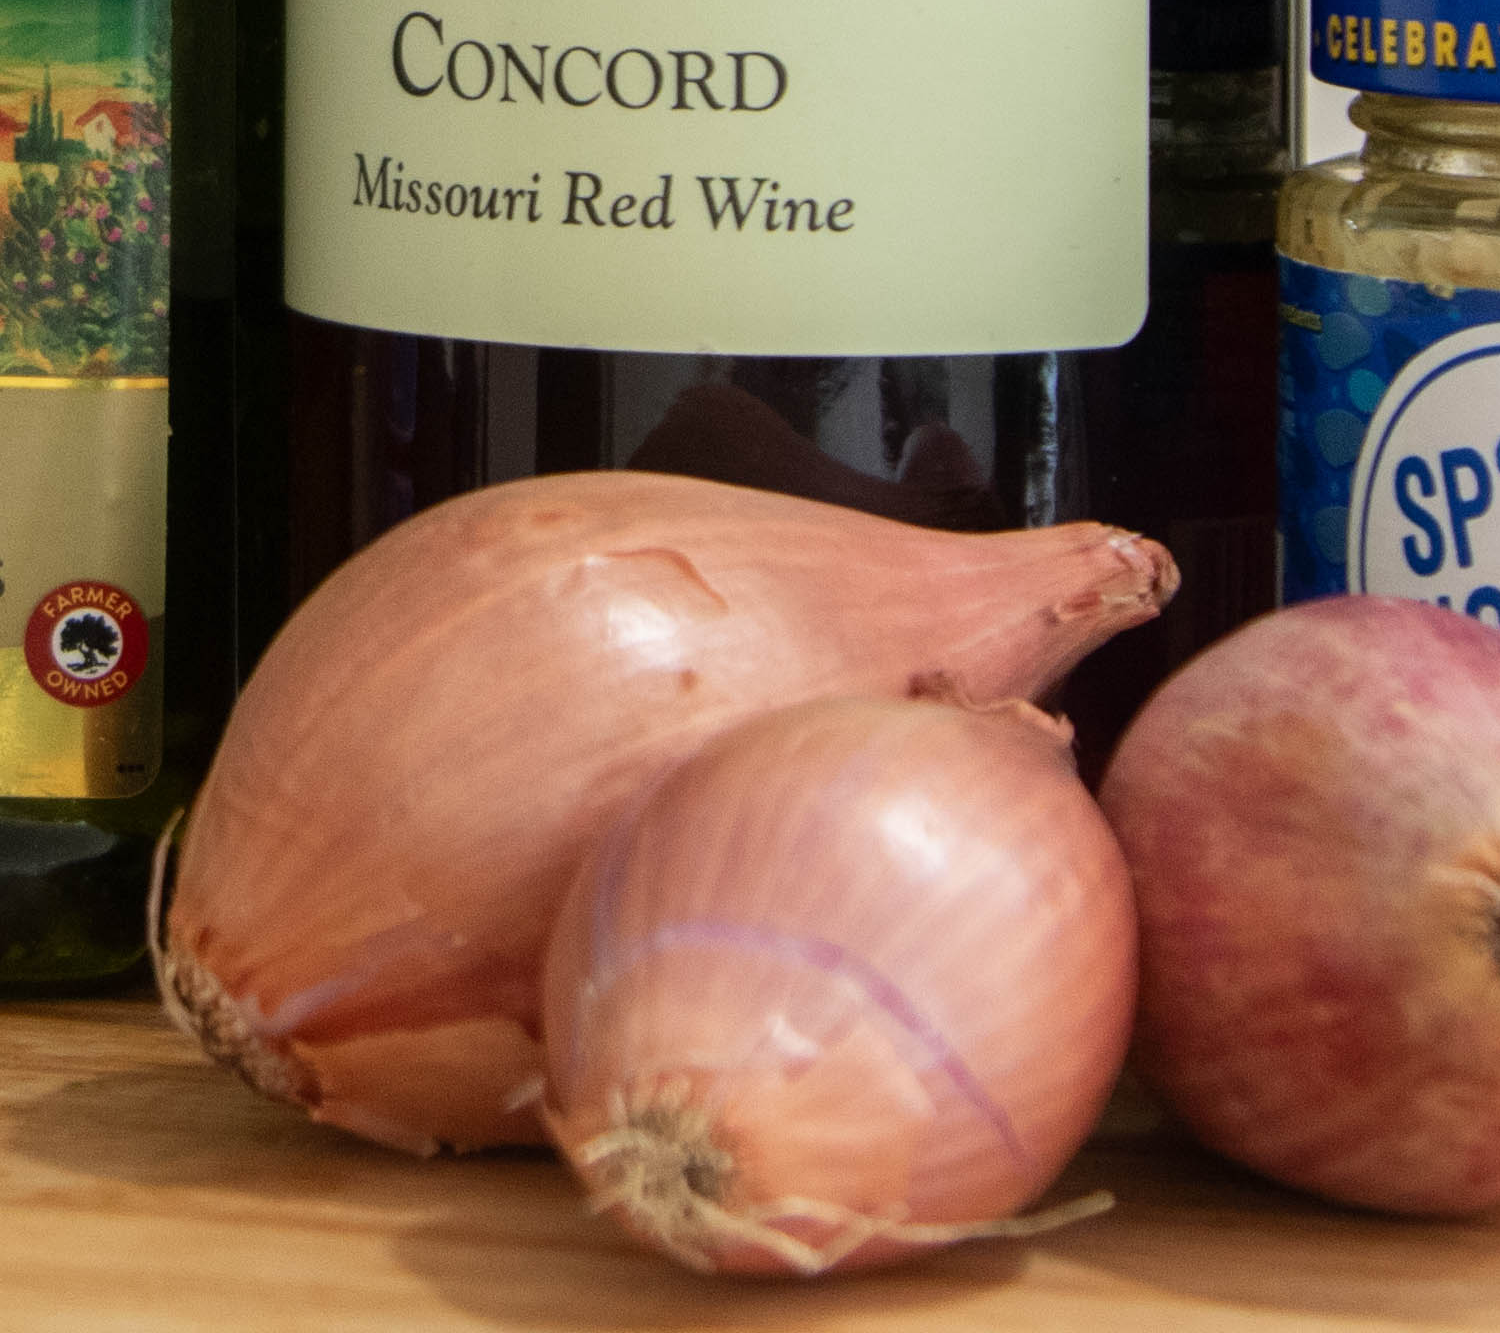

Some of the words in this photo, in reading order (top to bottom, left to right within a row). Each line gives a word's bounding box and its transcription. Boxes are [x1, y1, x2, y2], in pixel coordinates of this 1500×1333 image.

[391, 11, 788, 112] CONCORD
[352, 152, 543, 224] Missouri
[561, 170, 676, 230] Red
[695, 174, 857, 235] Wine
[42, 585, 135, 622] FARMER
[45, 668, 129, 700] OWNED
